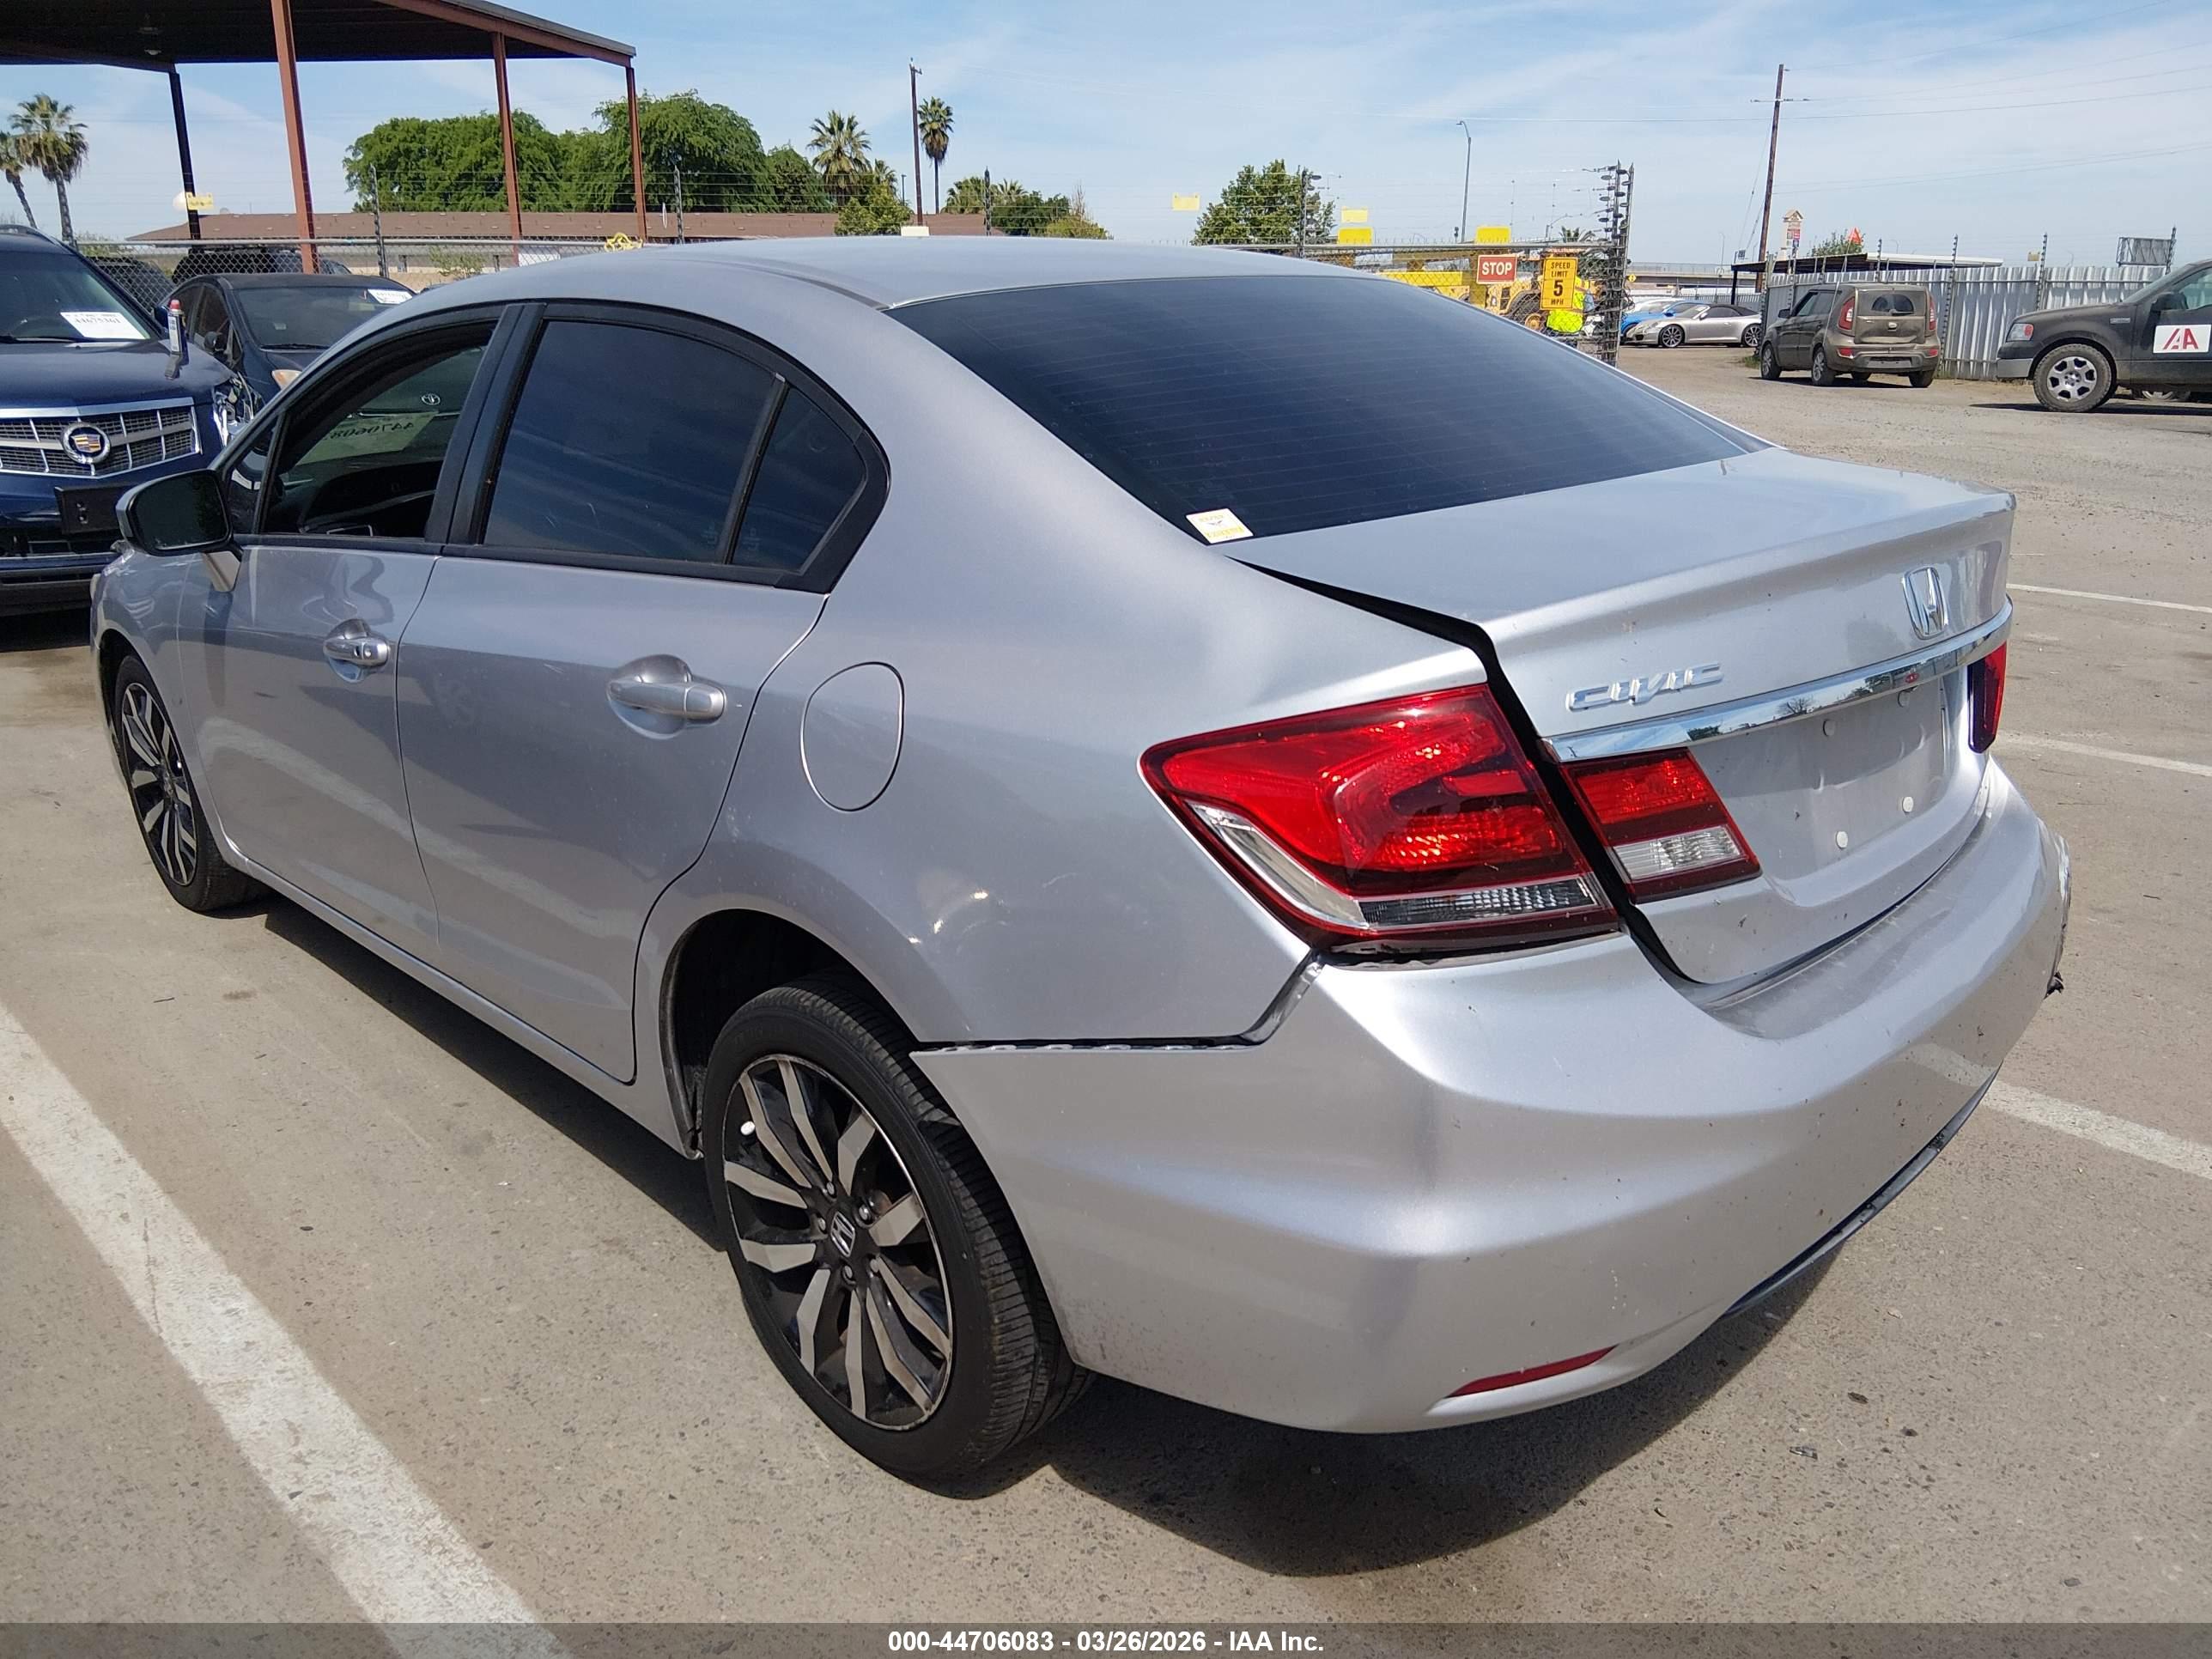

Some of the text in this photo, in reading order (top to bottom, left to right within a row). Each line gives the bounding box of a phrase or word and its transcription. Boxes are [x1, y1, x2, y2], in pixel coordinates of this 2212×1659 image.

[1481, 261, 1512, 276] STOP
[1553, 280, 1564, 296] 5
[1565, 663, 1723, 712] CIVIC
